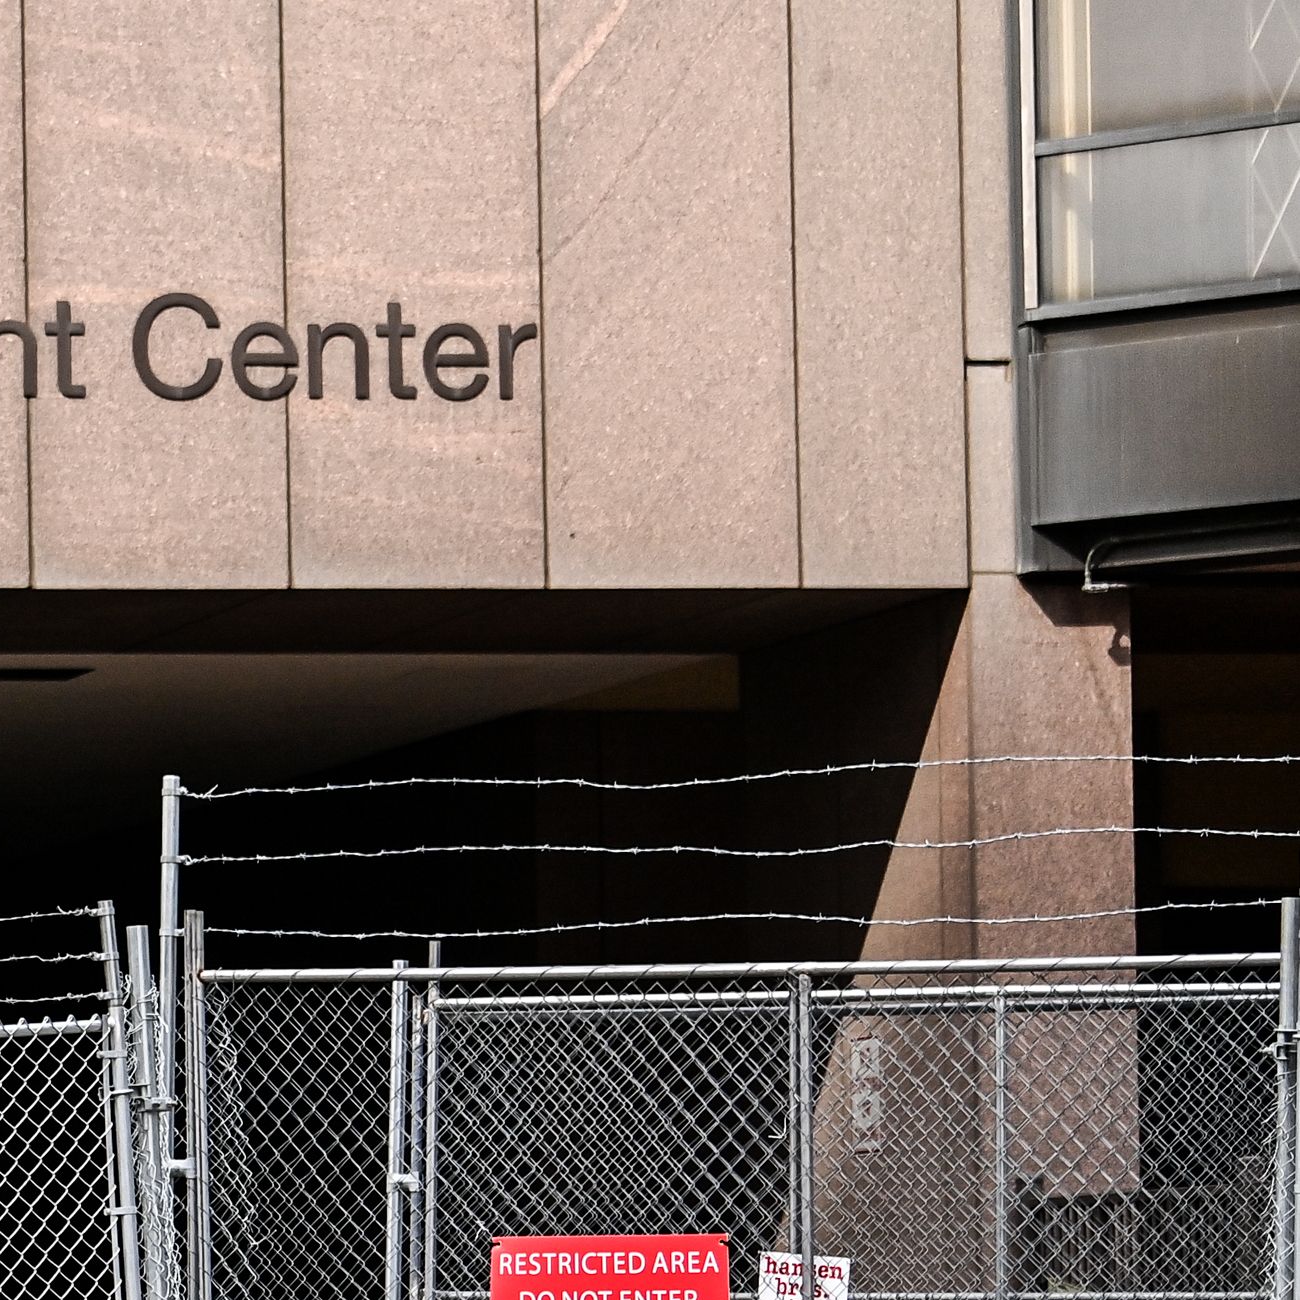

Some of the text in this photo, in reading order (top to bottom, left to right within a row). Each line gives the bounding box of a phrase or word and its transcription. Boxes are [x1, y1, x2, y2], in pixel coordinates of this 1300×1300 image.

[131, 292, 538, 401] Center
[499, 1250, 720, 1275] RESTRICTED AREA
[764, 1256, 844, 1280] hanen
[774, 1277, 830, 1299] brs.
